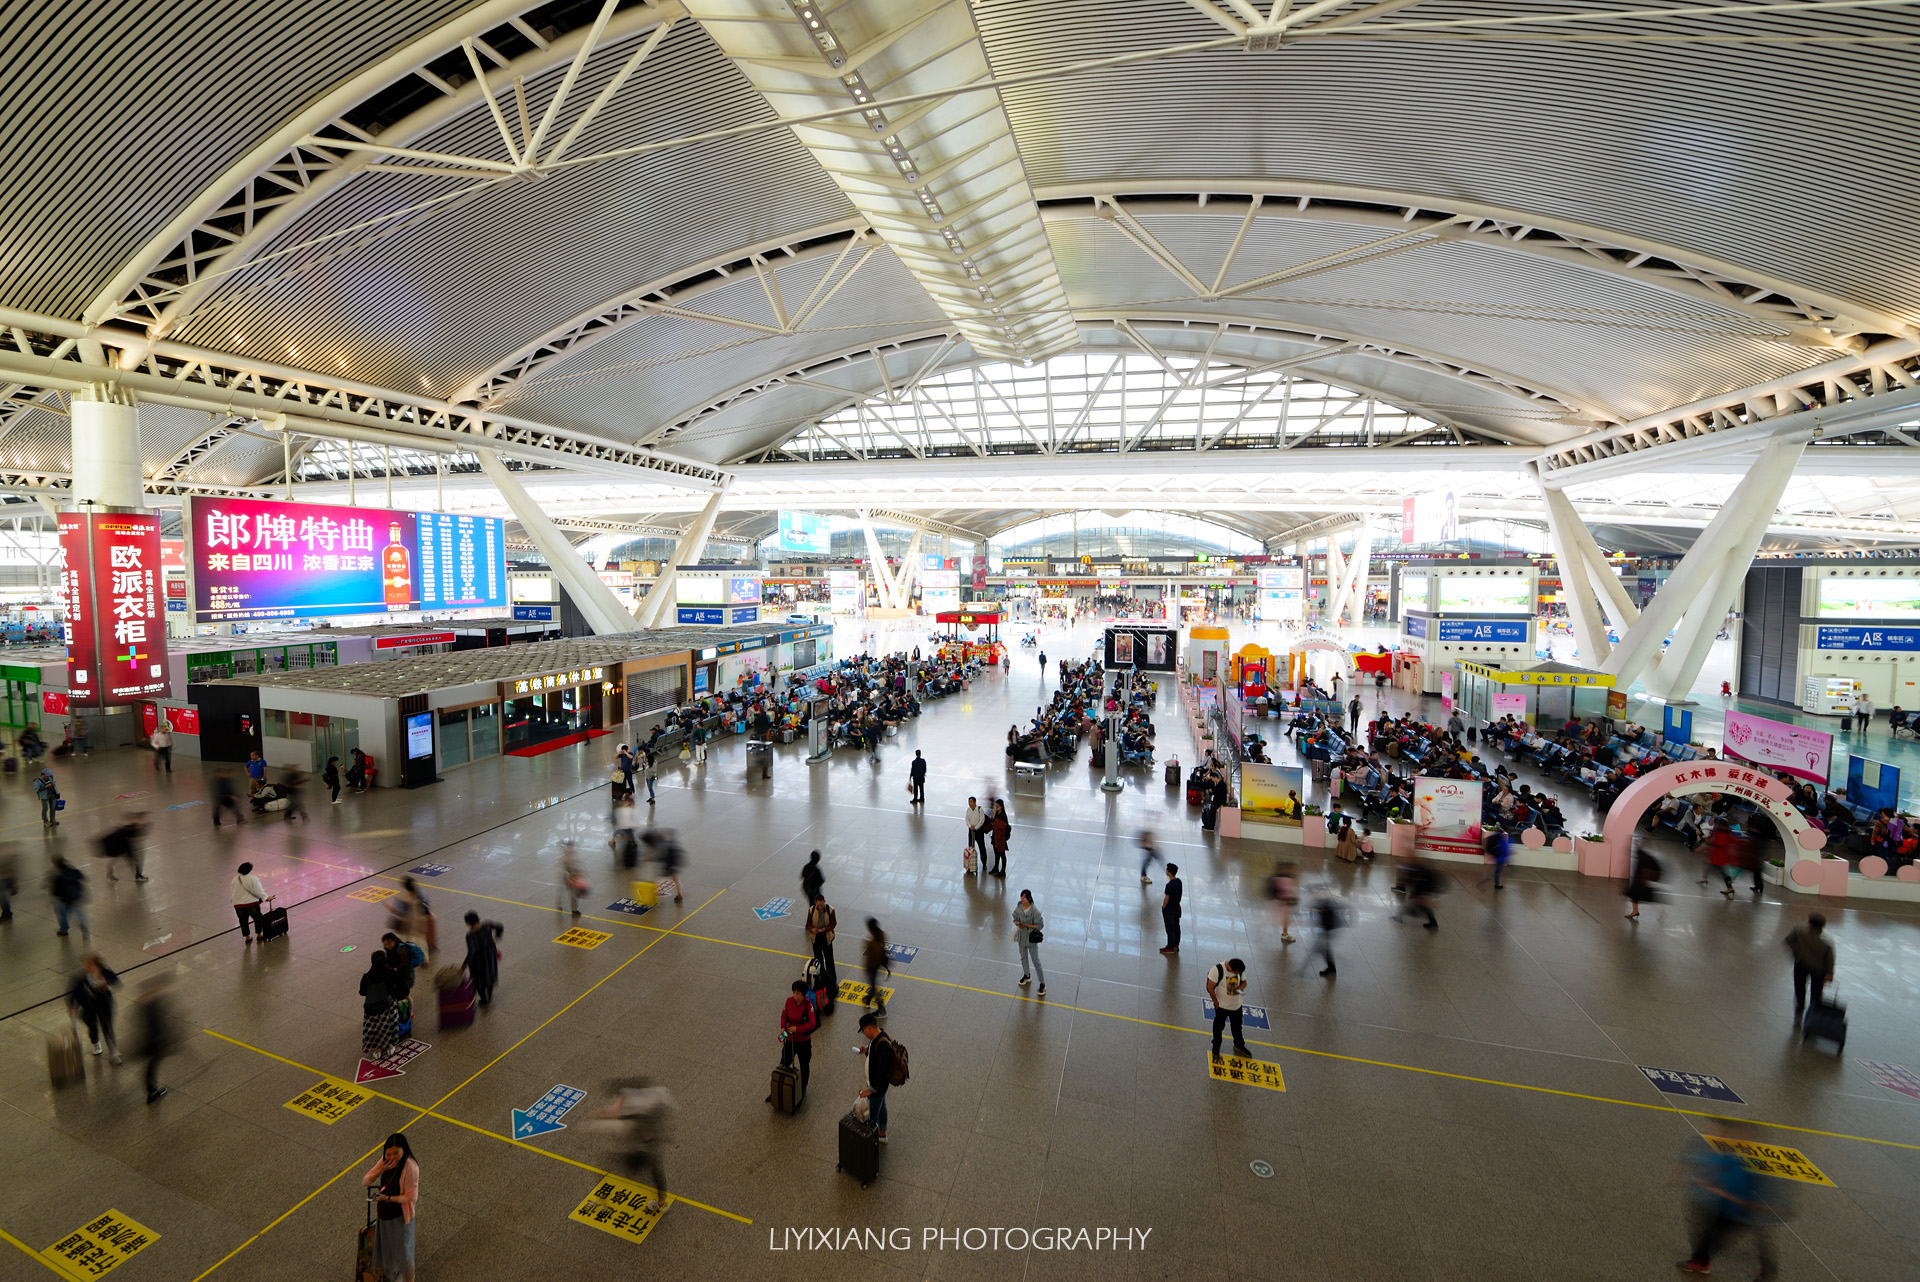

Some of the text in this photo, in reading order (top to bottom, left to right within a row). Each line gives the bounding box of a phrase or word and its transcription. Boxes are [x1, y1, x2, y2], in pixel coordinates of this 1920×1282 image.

[207, 509, 373, 551] 郎牌特曲
[208, 553, 374, 571] 来自四川 浓香正宗
[111, 545, 146, 644] 欧派衣柜
[145, 570, 156, 618] 高端全屋定制
[515, 667, 603, 694] 高铁商务休息室
[1521, 674, 1597, 684] 爱心妈妈屋
[1675, 768, 1768, 789] 红木棉 爱传递
[1212, 1065, 1281, 1088] 行走通道
[1641, 1066, 1725, 1090] 候车区域
[292, 1092, 348, 1121] 行走通道
[312, 1082, 367, 1105] 请勿停留
[577, 1198, 651, 1237] 行走通道
[86, 1215, 149, 1255] 请勿停留
[53, 1232, 120, 1276] 行走通道
